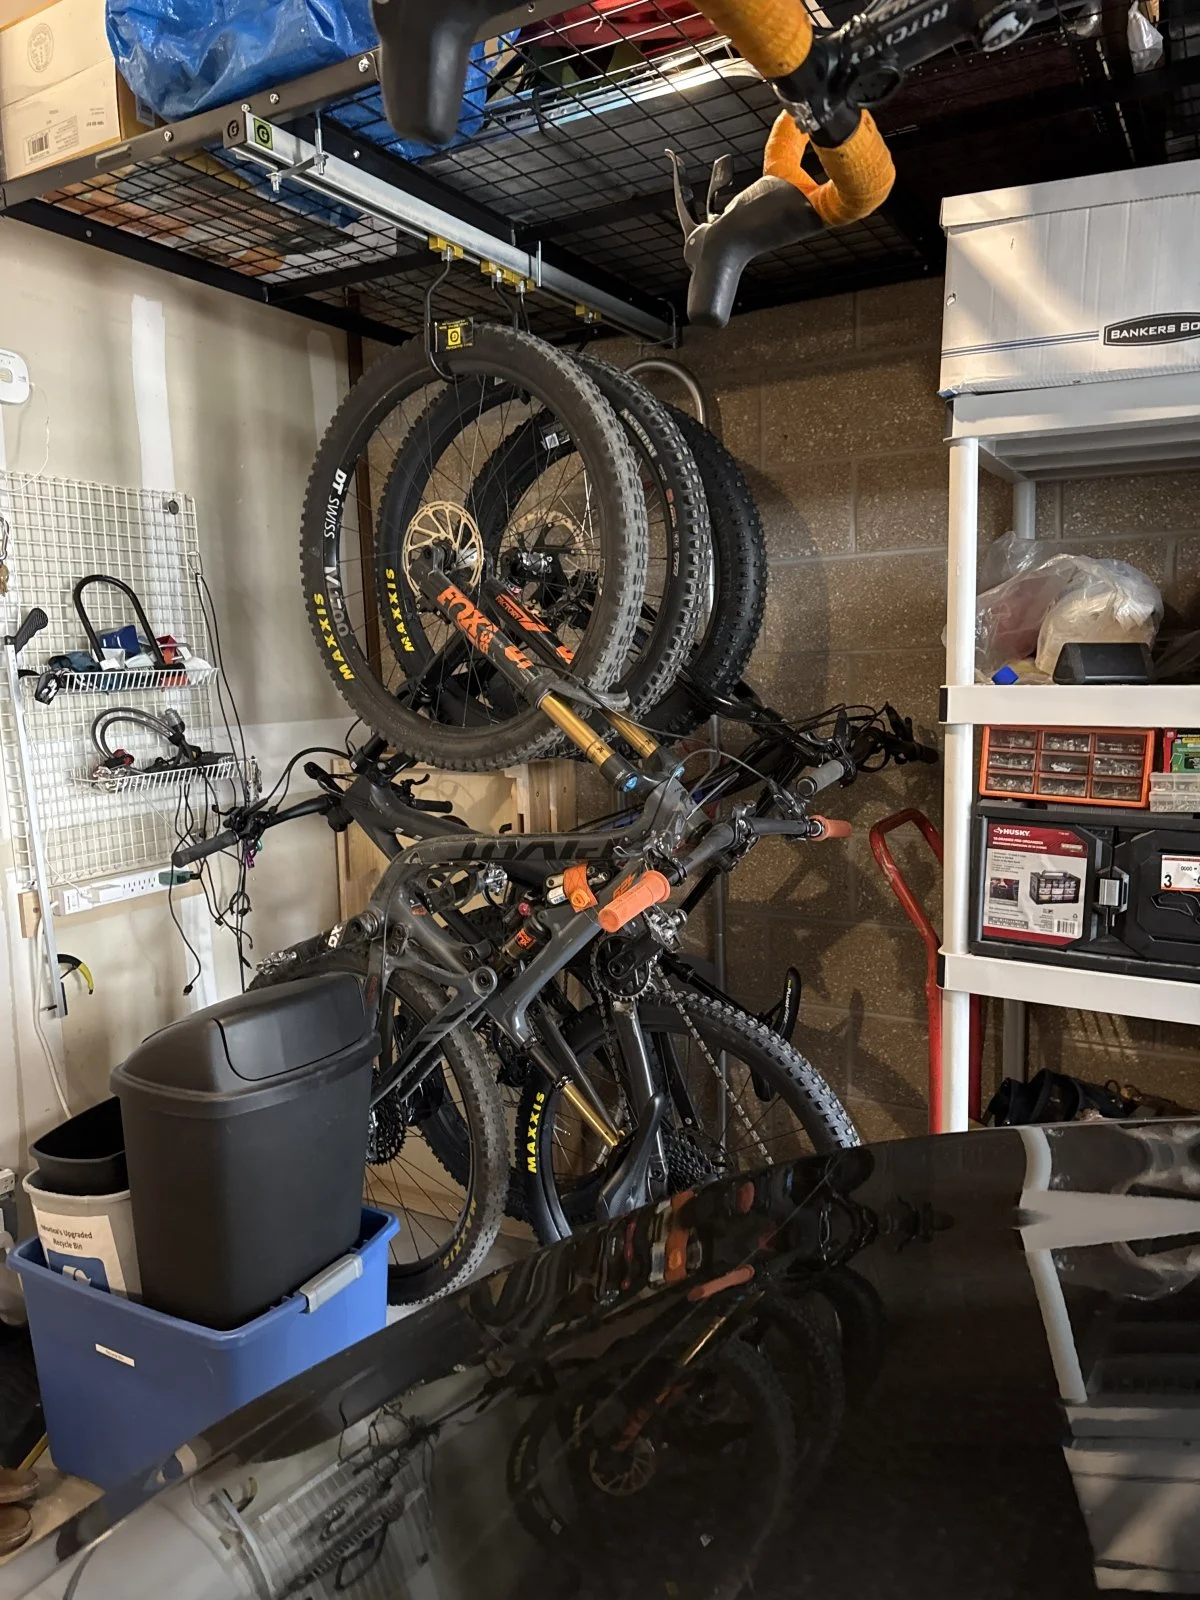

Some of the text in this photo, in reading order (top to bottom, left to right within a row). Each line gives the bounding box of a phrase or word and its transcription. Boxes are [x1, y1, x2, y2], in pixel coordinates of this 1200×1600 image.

[1110, 321, 1200, 339] BANKERS BO
[324, 468, 348, 539] DT SWISS
[313, 593, 355, 680] MAXXIS
[385, 568, 415, 652] MAXXIS
[437, 584, 498, 650] FOX
[1003, 828, 1031, 837] HUSKY
[527, 1092, 545, 1174] MAXXIS
[63, 1230, 93, 1239] Upgraded
